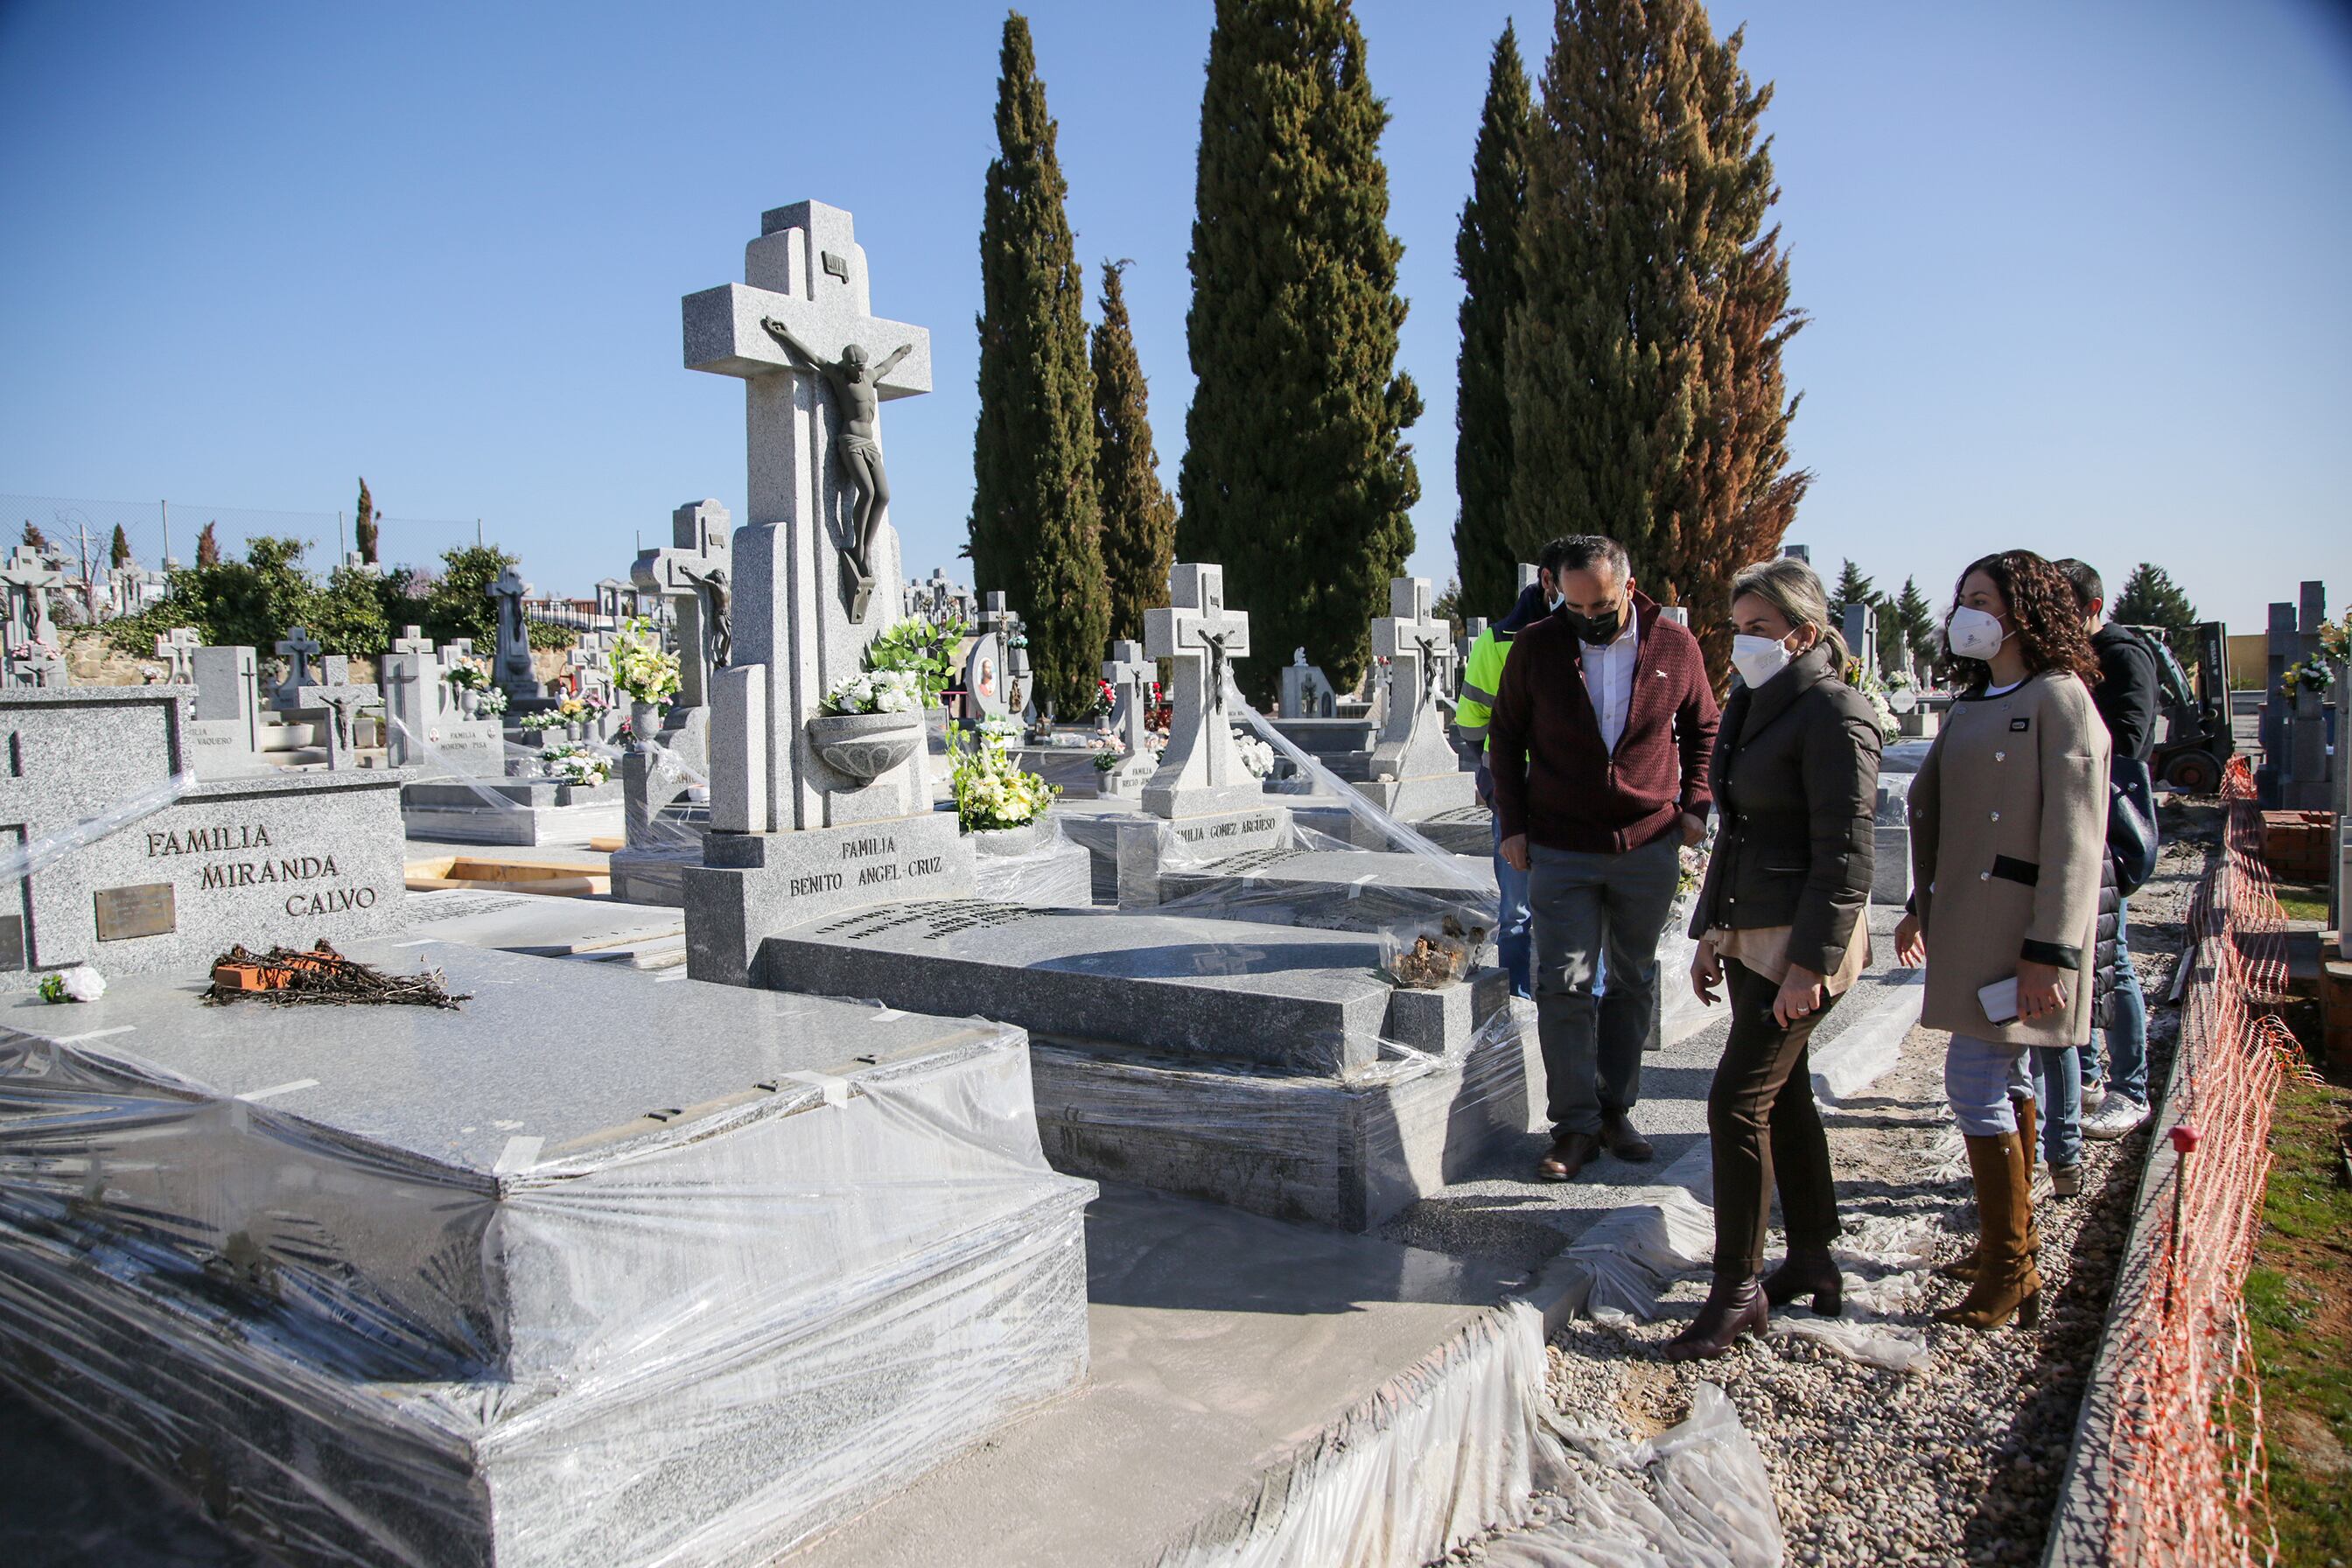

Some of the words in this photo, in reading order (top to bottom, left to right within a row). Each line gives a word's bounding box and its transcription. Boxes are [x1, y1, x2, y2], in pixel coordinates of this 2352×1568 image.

[2209, 640, 2218, 665] NISSAN
[197, 737, 233, 746] VAQUERO
[440, 742, 468, 751] MORENO
[1210, 822, 1237, 839] GOMEZ
[1241, 814, 1276, 834] ARGÜESO
[146, 823, 273, 858] FAMILIA
[842, 836, 896, 860] FAMILIA
[200, 854, 340, 891] MIRANDA
[790, 873, 844, 898] BENITO
[285, 887, 377, 917] CALVO
